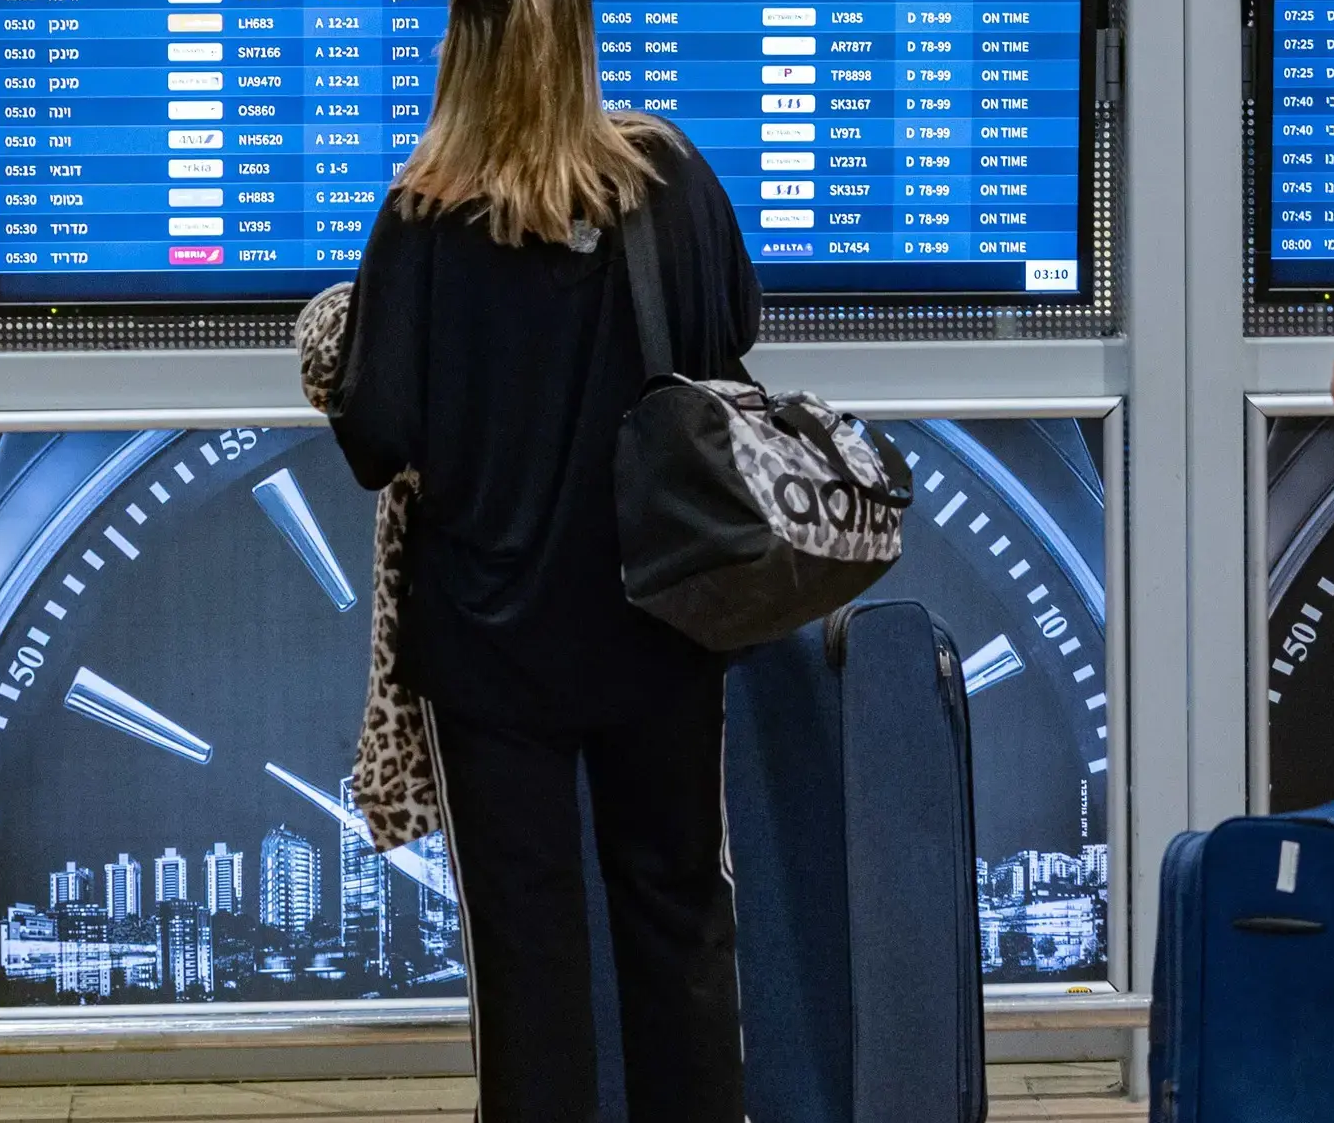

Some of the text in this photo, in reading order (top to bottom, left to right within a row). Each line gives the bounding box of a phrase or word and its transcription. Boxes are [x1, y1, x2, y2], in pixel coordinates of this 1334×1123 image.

[1283, 96, 1314, 107] 07:40
[772, 241, 1027, 254] DELTA DL7454 D 78-99 ON TIME
[1281, 239, 1312, 250] 08:00
[5, 249, 362, 264] 05:30 מדריד IBERIA IB7714 D 78-99
[1033, 269, 1069, 280] 03:10
[1032, 603, 1068, 639] 10
[1282, 622, 1317, 662] 50
[7, 646, 45, 687] 50
